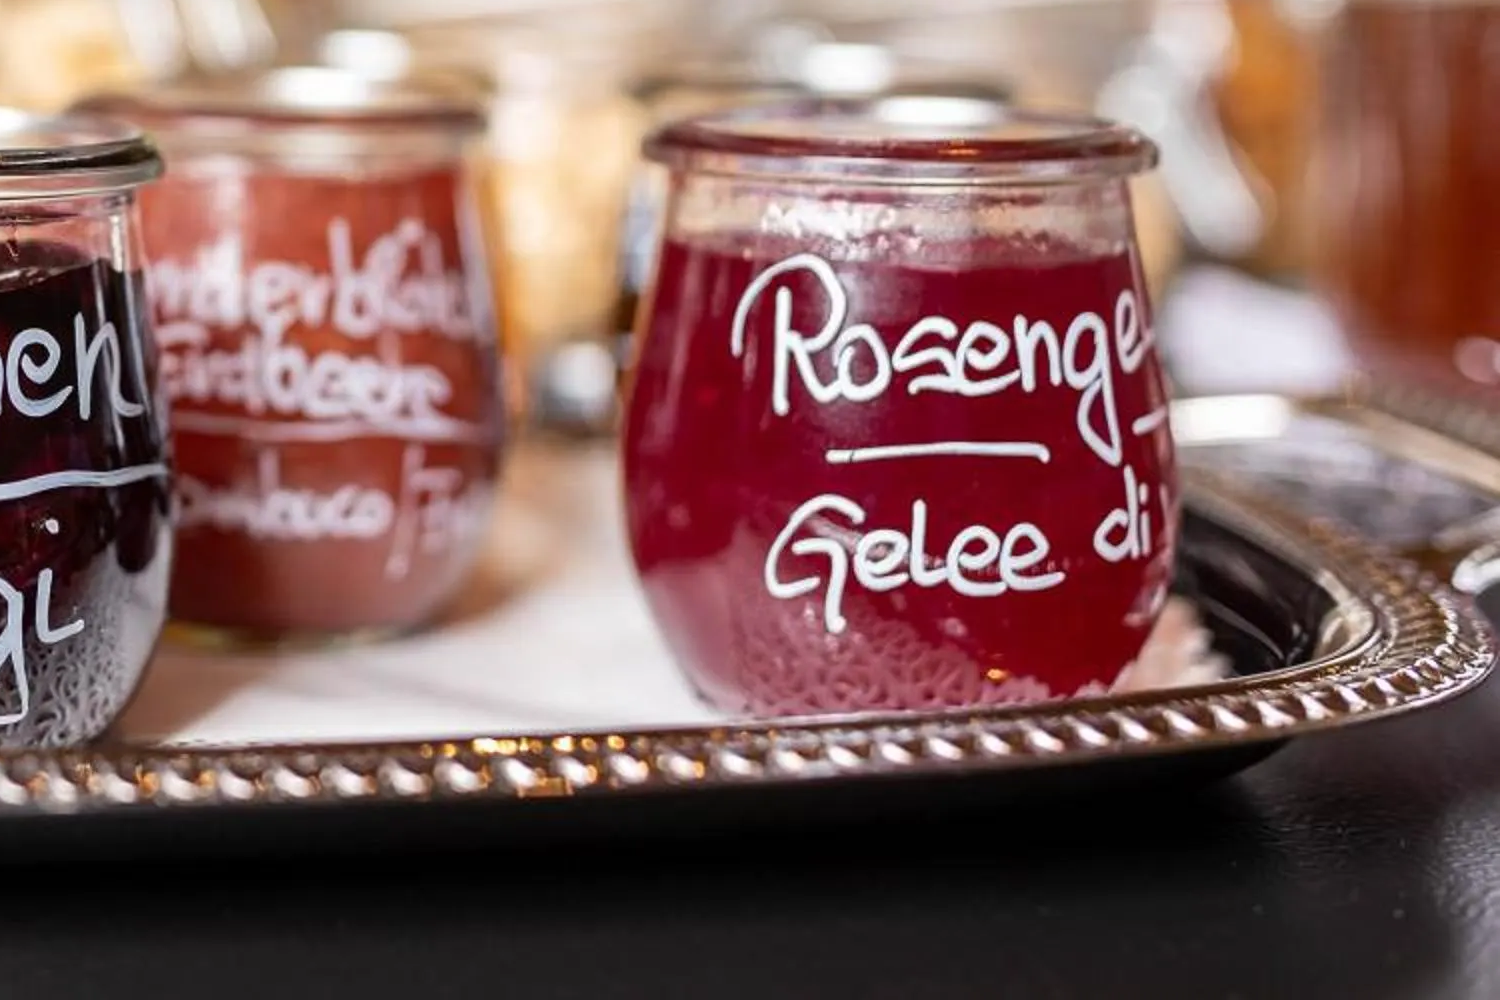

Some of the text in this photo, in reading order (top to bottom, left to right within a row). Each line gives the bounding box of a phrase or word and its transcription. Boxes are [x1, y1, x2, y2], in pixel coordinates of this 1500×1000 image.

[731, 253, 1154, 467] Rosenge
[765, 464, 1151, 634] Gelee di
